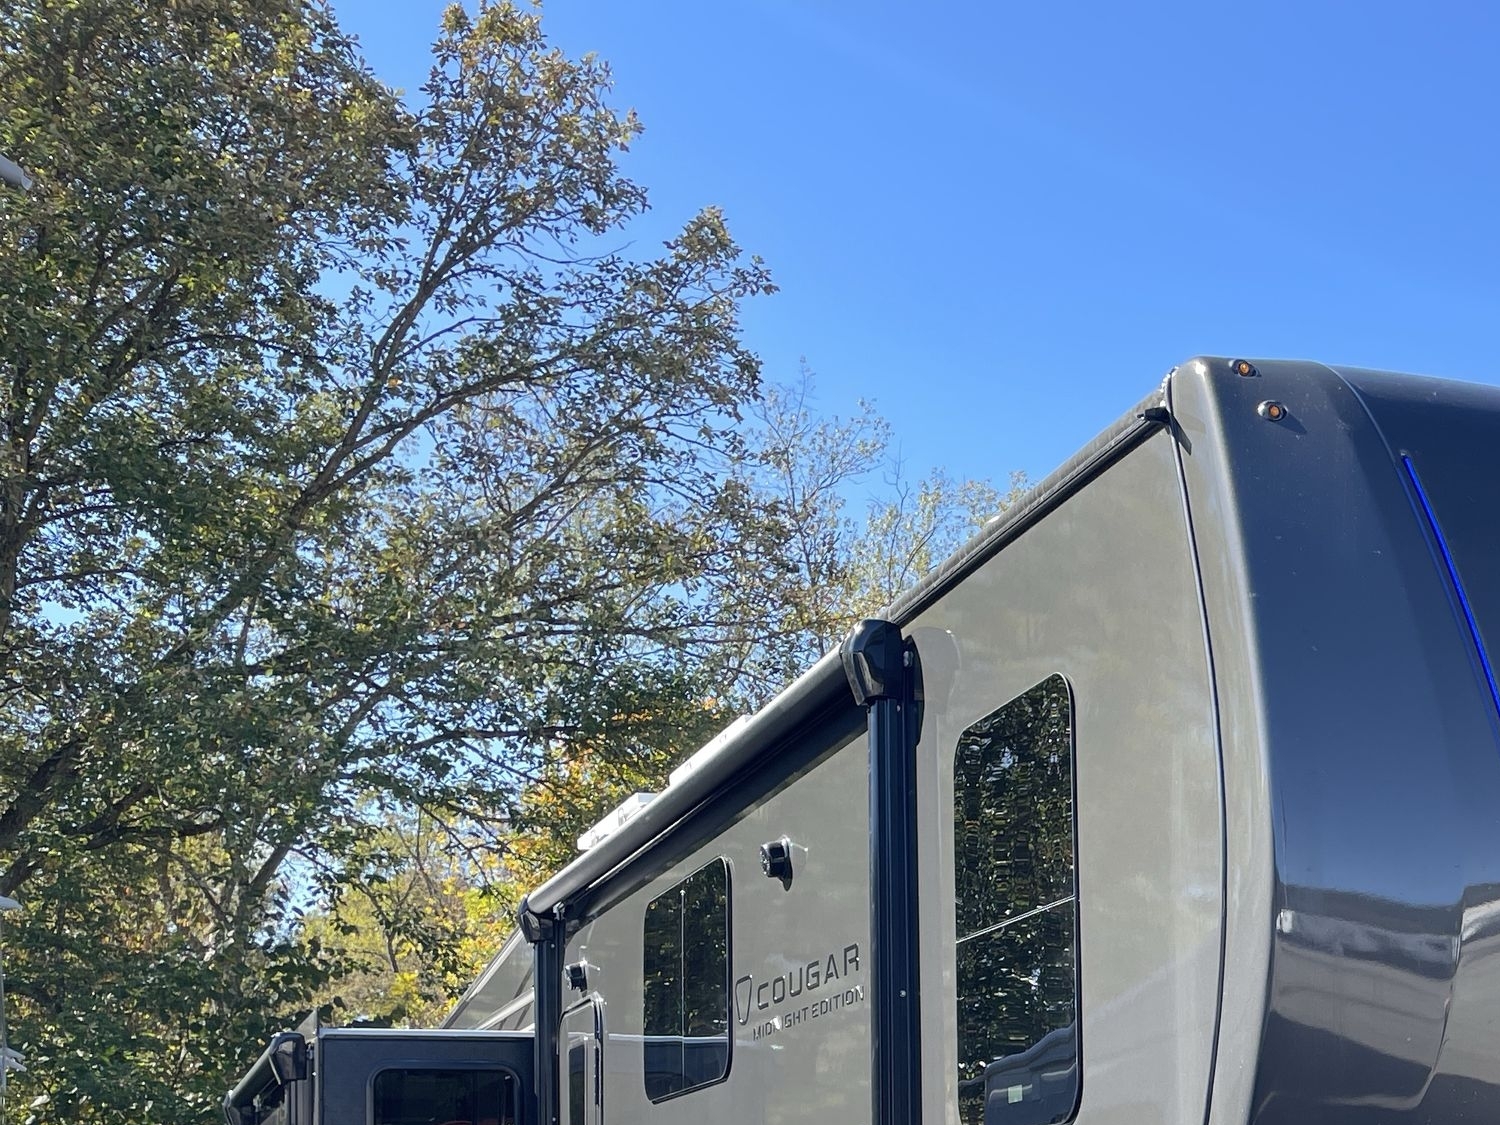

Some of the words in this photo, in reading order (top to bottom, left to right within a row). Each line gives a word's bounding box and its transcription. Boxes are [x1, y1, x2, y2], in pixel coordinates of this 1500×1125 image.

[757, 942, 860, 1011] COUGAR
[752, 1006, 809, 1041] MIDNIGHT
[811, 985, 865, 1018] EDITION
